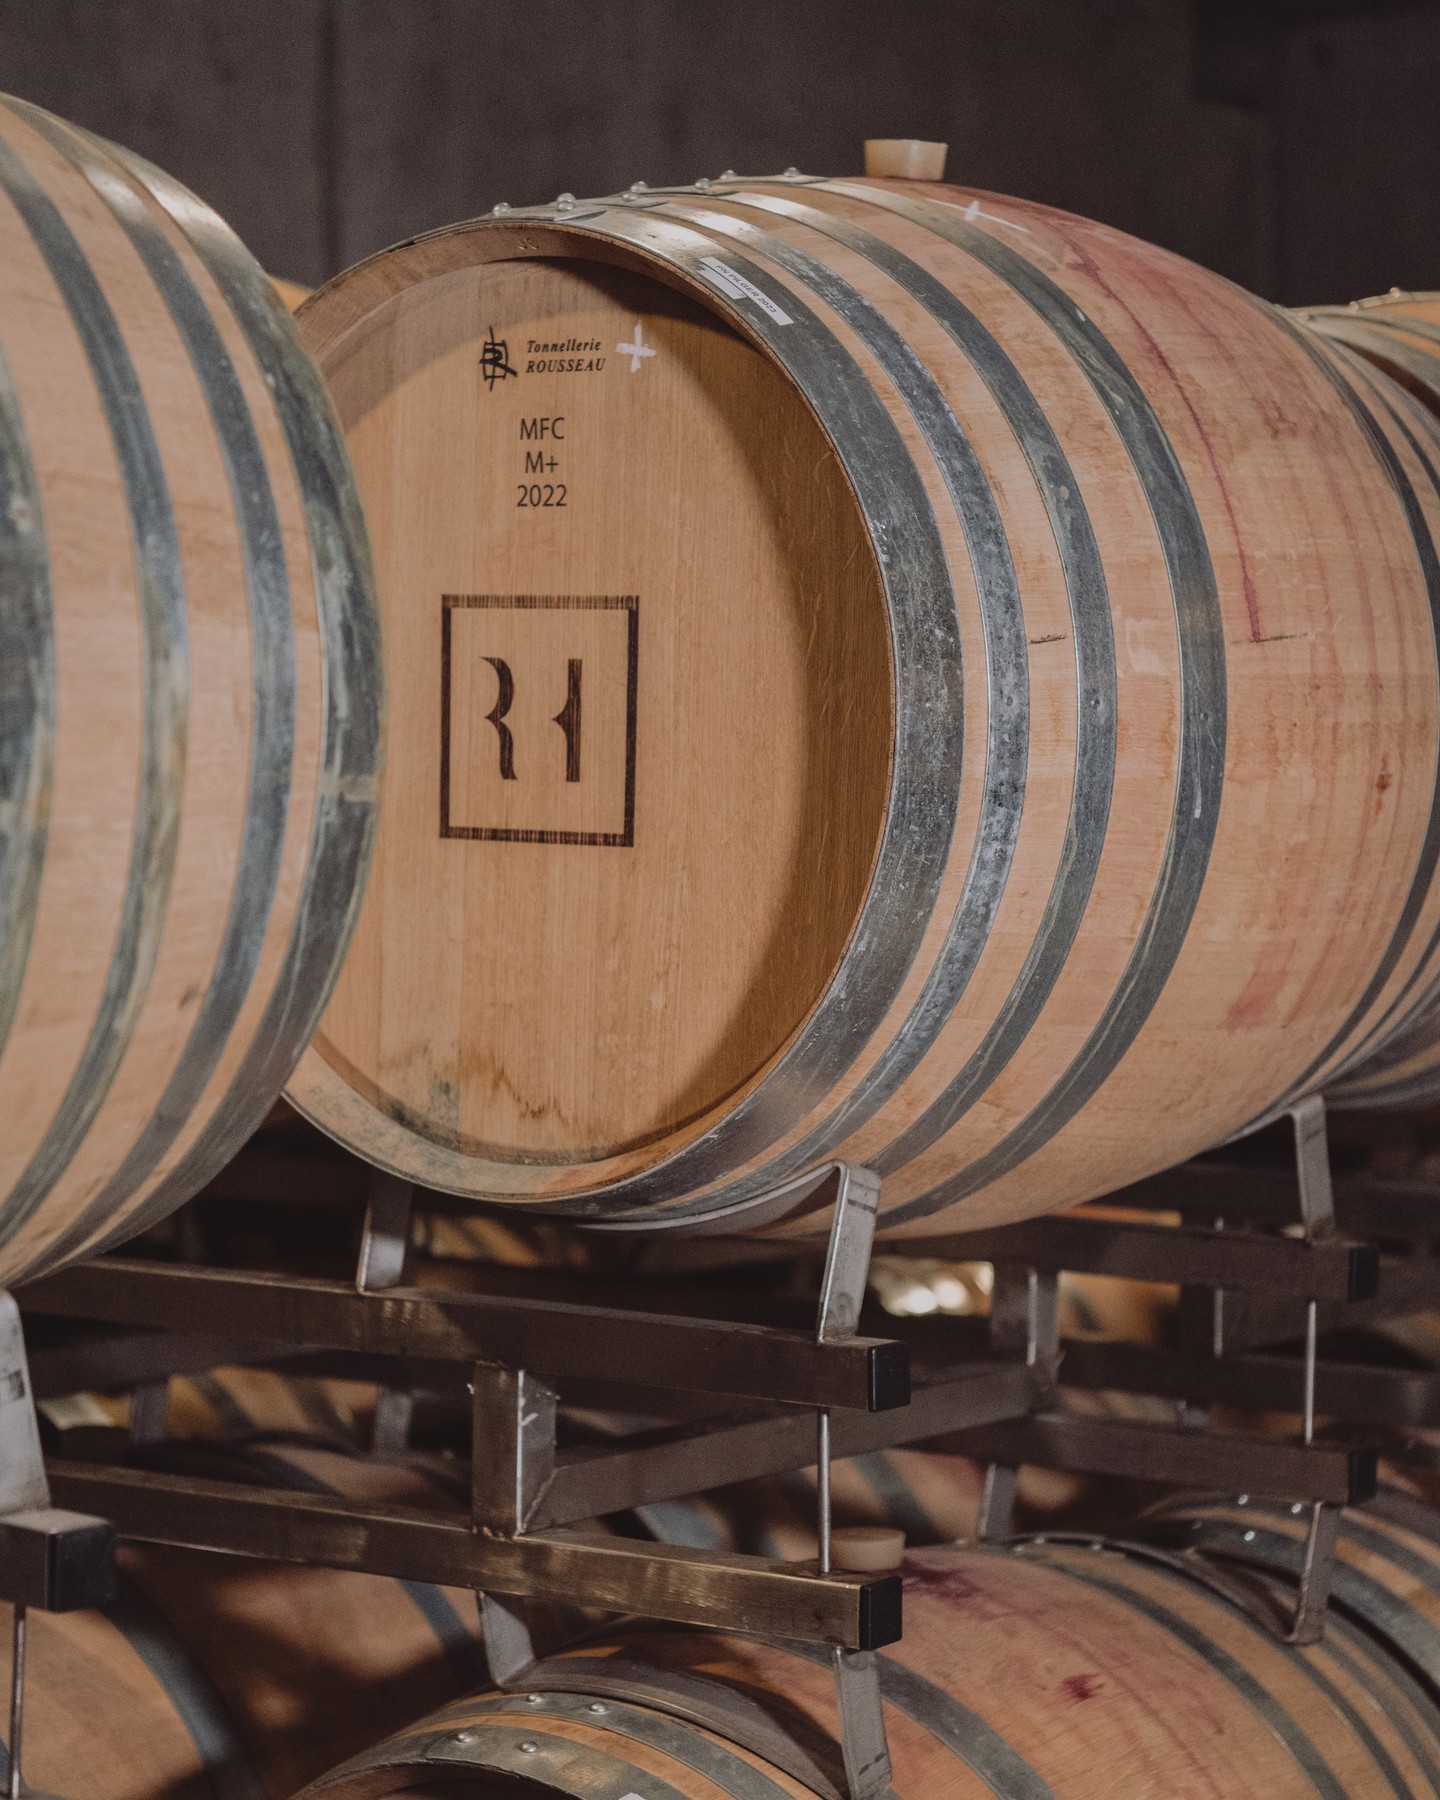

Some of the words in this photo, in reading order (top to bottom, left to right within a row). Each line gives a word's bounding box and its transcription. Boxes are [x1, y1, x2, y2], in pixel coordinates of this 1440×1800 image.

[729, 274, 760, 297] PILGER
[757, 296, 777, 313] 2023
[526, 338, 602, 354] Tonnellerie
[525, 358, 606, 374] ROUSSEAU
[519, 416, 565, 441] MFC
[524, 450, 559, 474] M+
[516, 483, 568, 508] 2022
